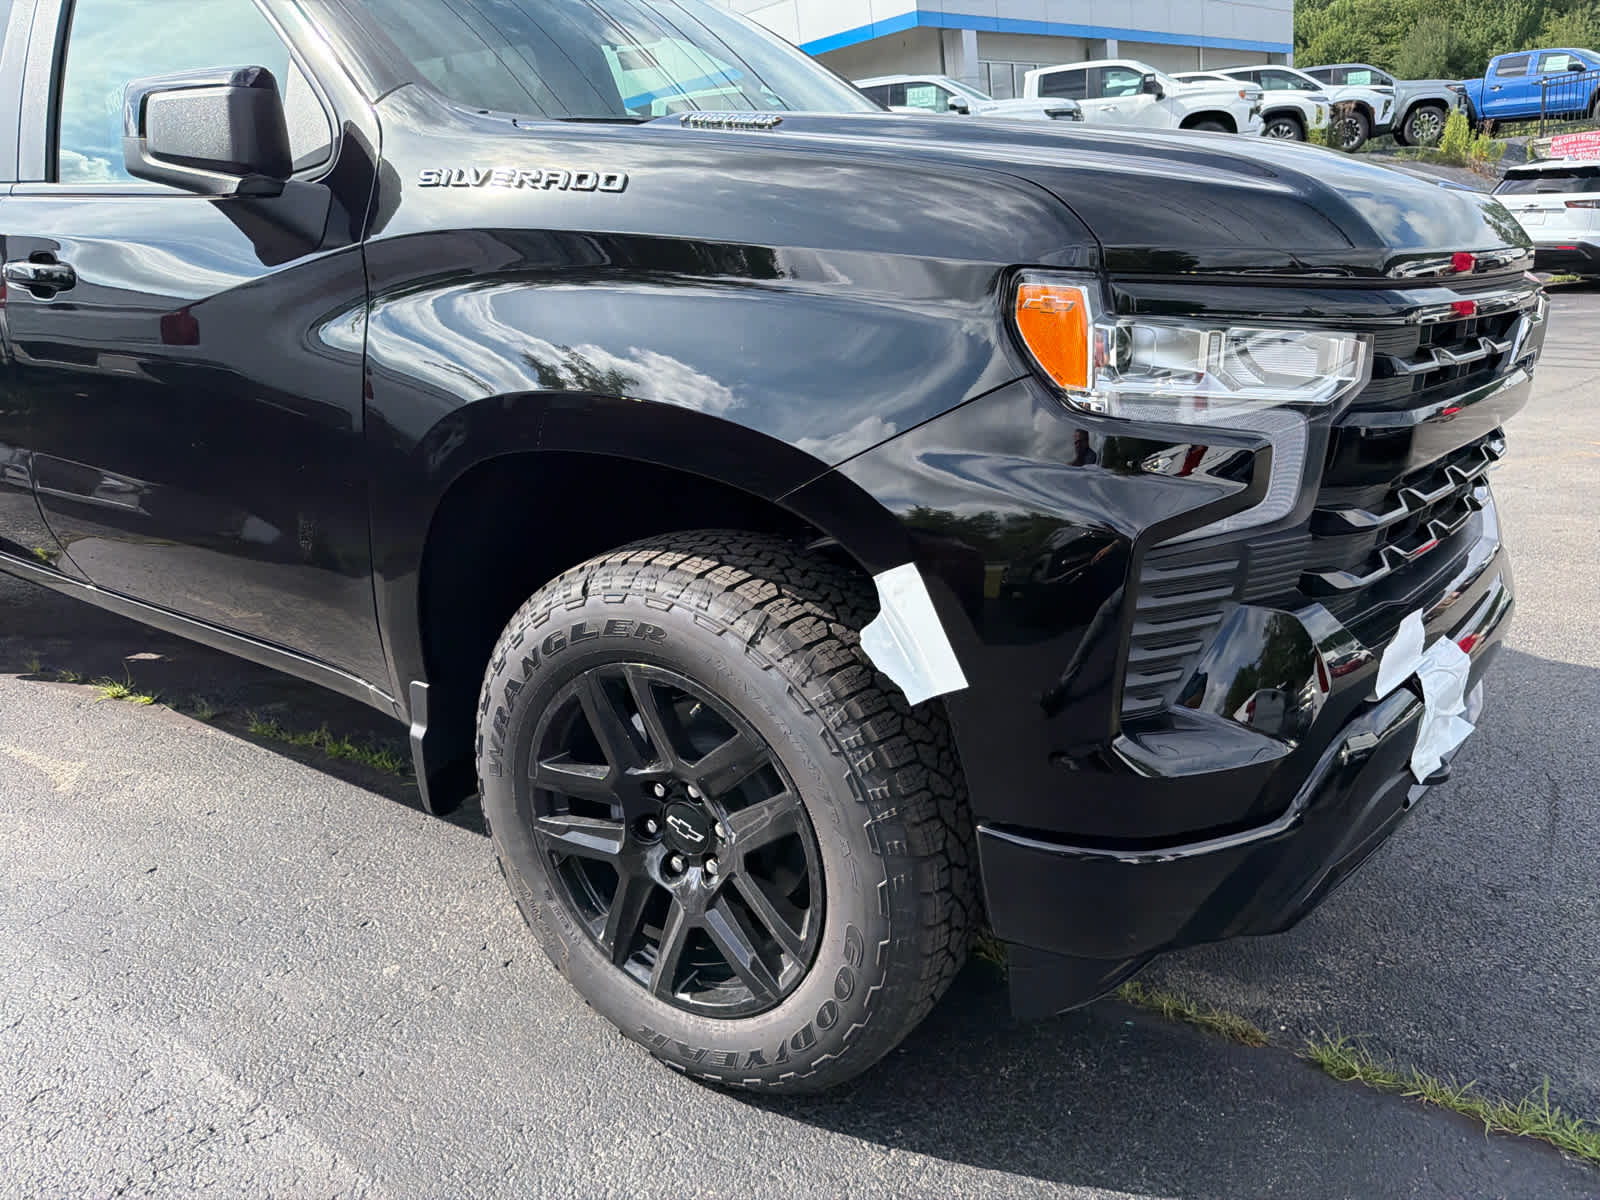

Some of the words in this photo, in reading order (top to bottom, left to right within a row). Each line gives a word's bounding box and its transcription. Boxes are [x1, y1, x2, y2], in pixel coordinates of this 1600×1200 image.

[418, 168, 629, 193] SILVERADO
[488, 617, 668, 777] WRANGLER
[637, 922, 864, 1070] GOODYEAR
